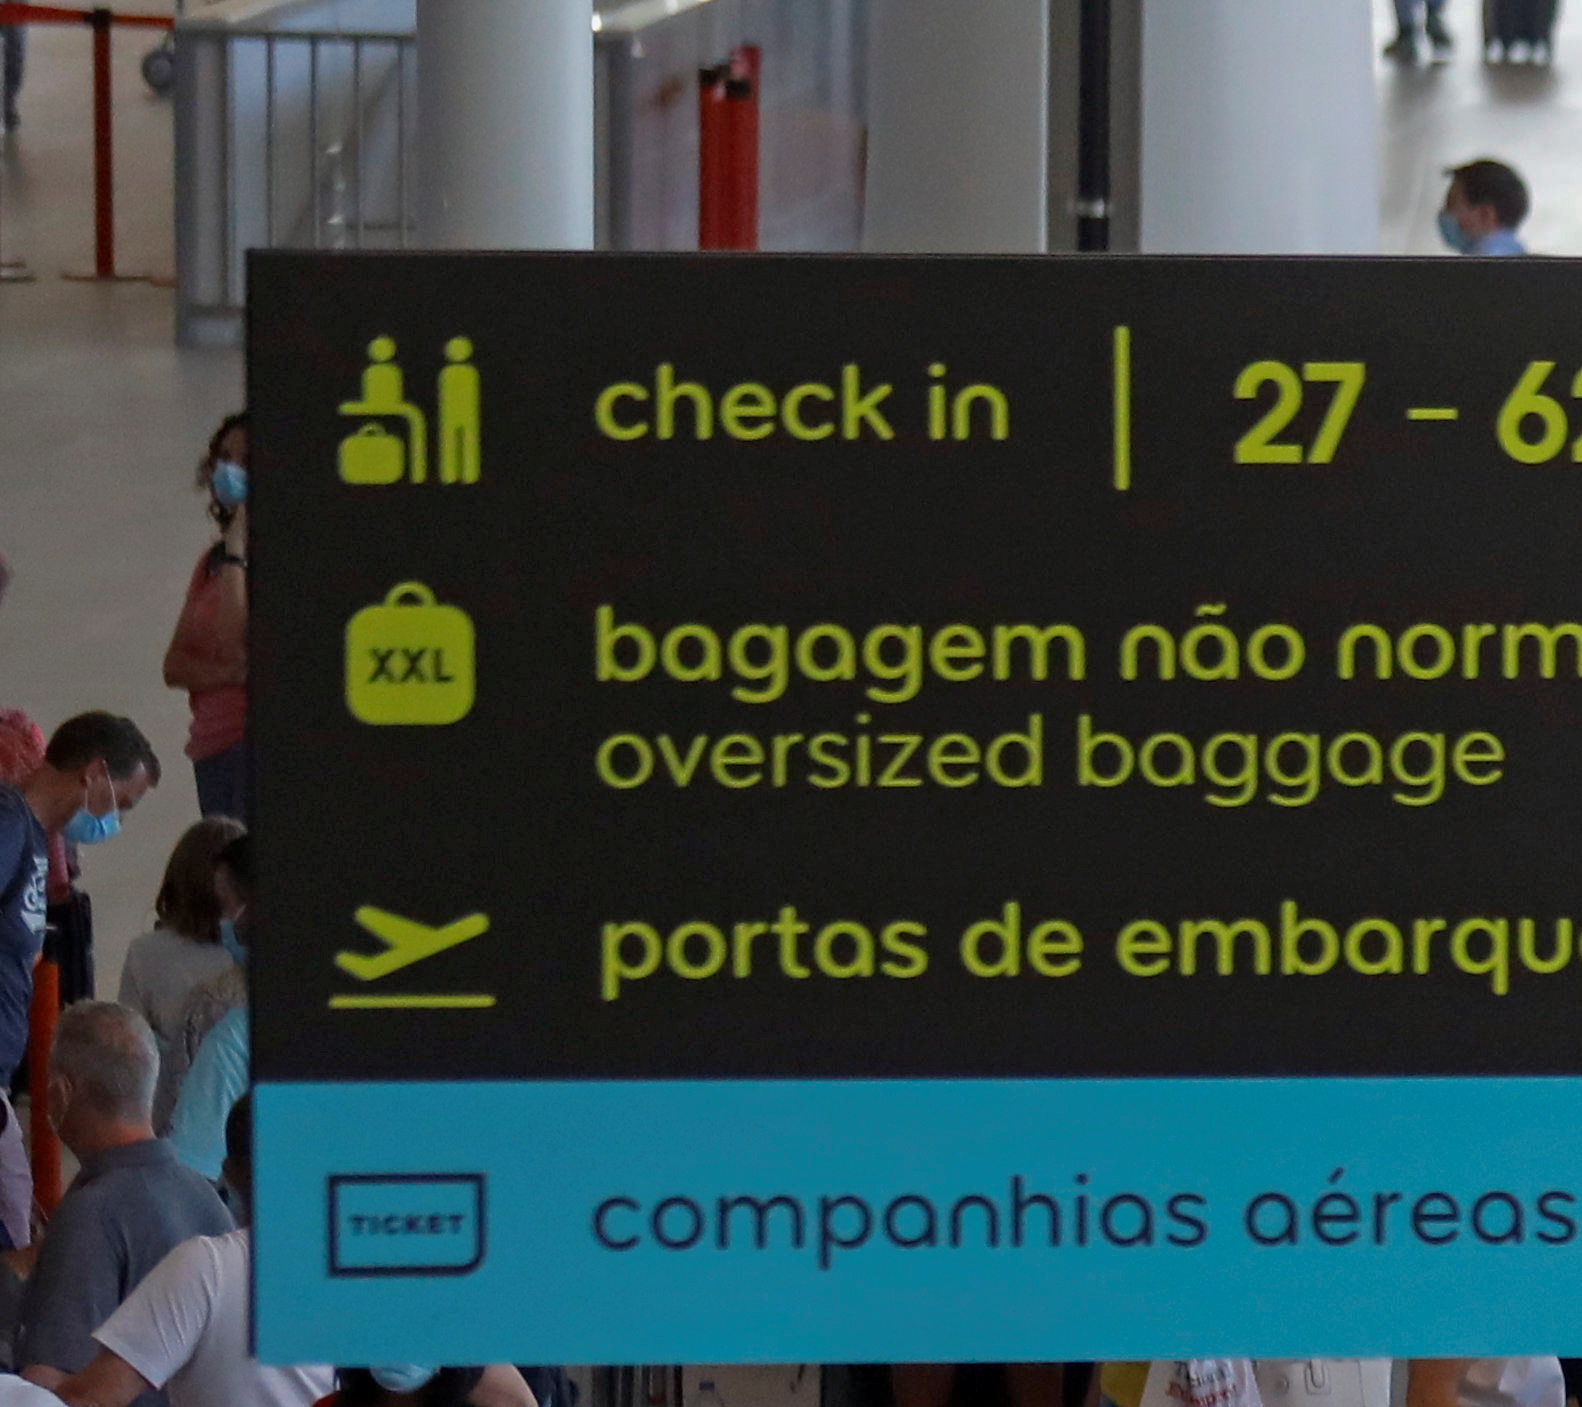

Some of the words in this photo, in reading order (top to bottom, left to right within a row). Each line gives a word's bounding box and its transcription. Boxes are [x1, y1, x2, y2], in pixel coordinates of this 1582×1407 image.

[594, 363, 895, 442] check
[928, 362, 1009, 441] in
[1233, 359, 1366, 465] 27
[367, 648, 454, 685] XXL
[596, 604, 1086, 705] bagagem
[1120, 602, 1306, 682] não
[596, 713, 1043, 790] oversized
[1077, 713, 1505, 808] baggage
[601, 905, 929, 1002] portas
[960, 900, 1084, 979] de
[350, 1213, 465, 1236] TICKET
[589, 1171, 1209, 1273] companhias
[1242, 1166, 1579, 1248] aéreas
